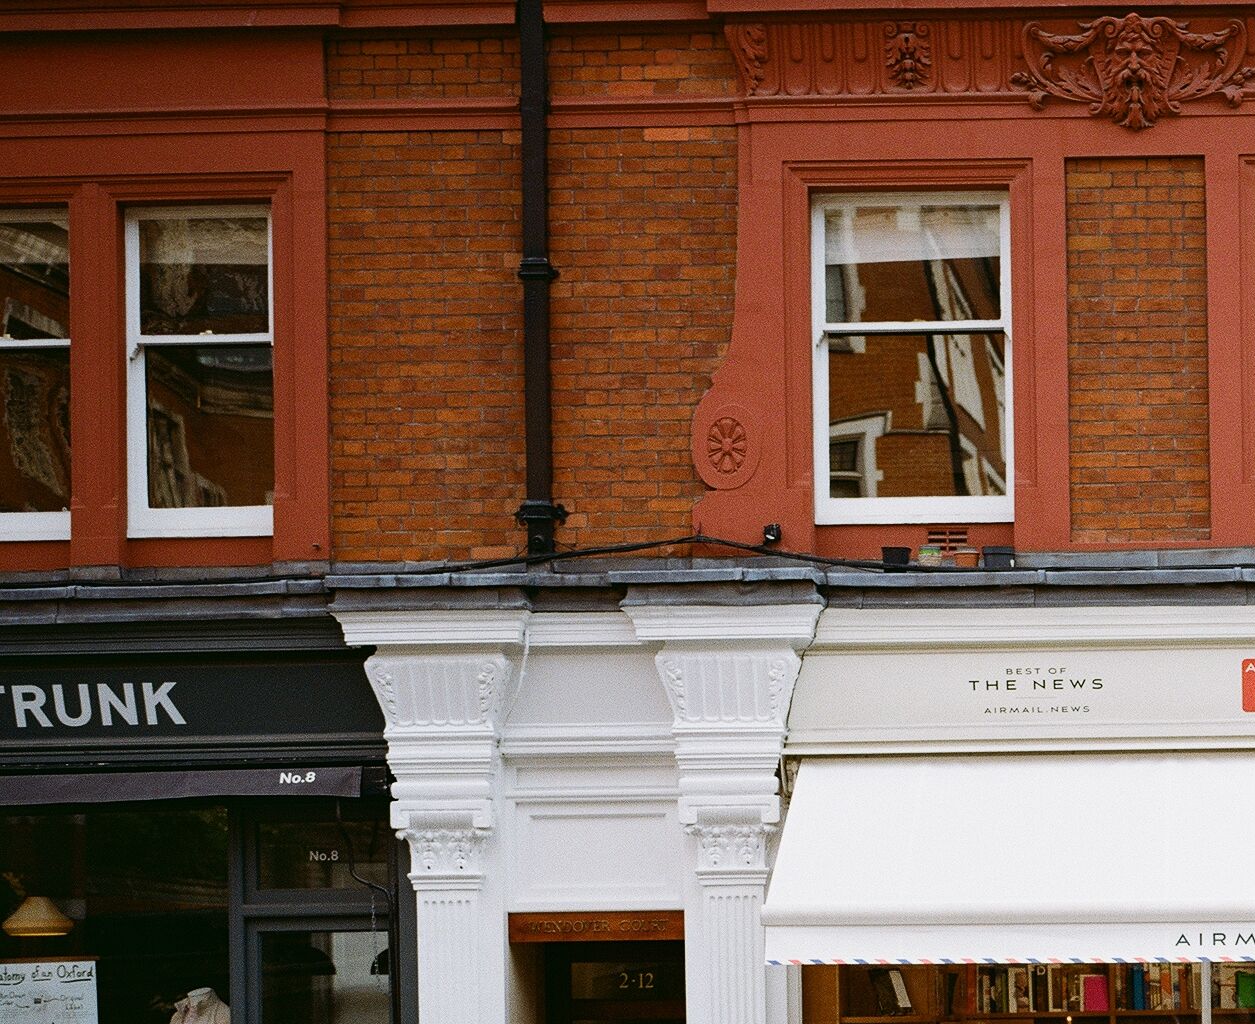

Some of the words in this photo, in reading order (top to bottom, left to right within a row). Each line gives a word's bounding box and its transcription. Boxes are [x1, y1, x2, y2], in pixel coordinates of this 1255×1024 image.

[1048, 667, 1067, 675] OF
[969, 679, 1018, 691] THE
[1032, 678, 1104, 690] NEWS
[0, 682, 187, 728] RUNK
[984, 705, 1091, 714] AIRMAIL.NEWS
[279, 771, 316, 784] No.8
[309, 850, 339, 862] No.8
[57, 965, 94, 979] Oxford
